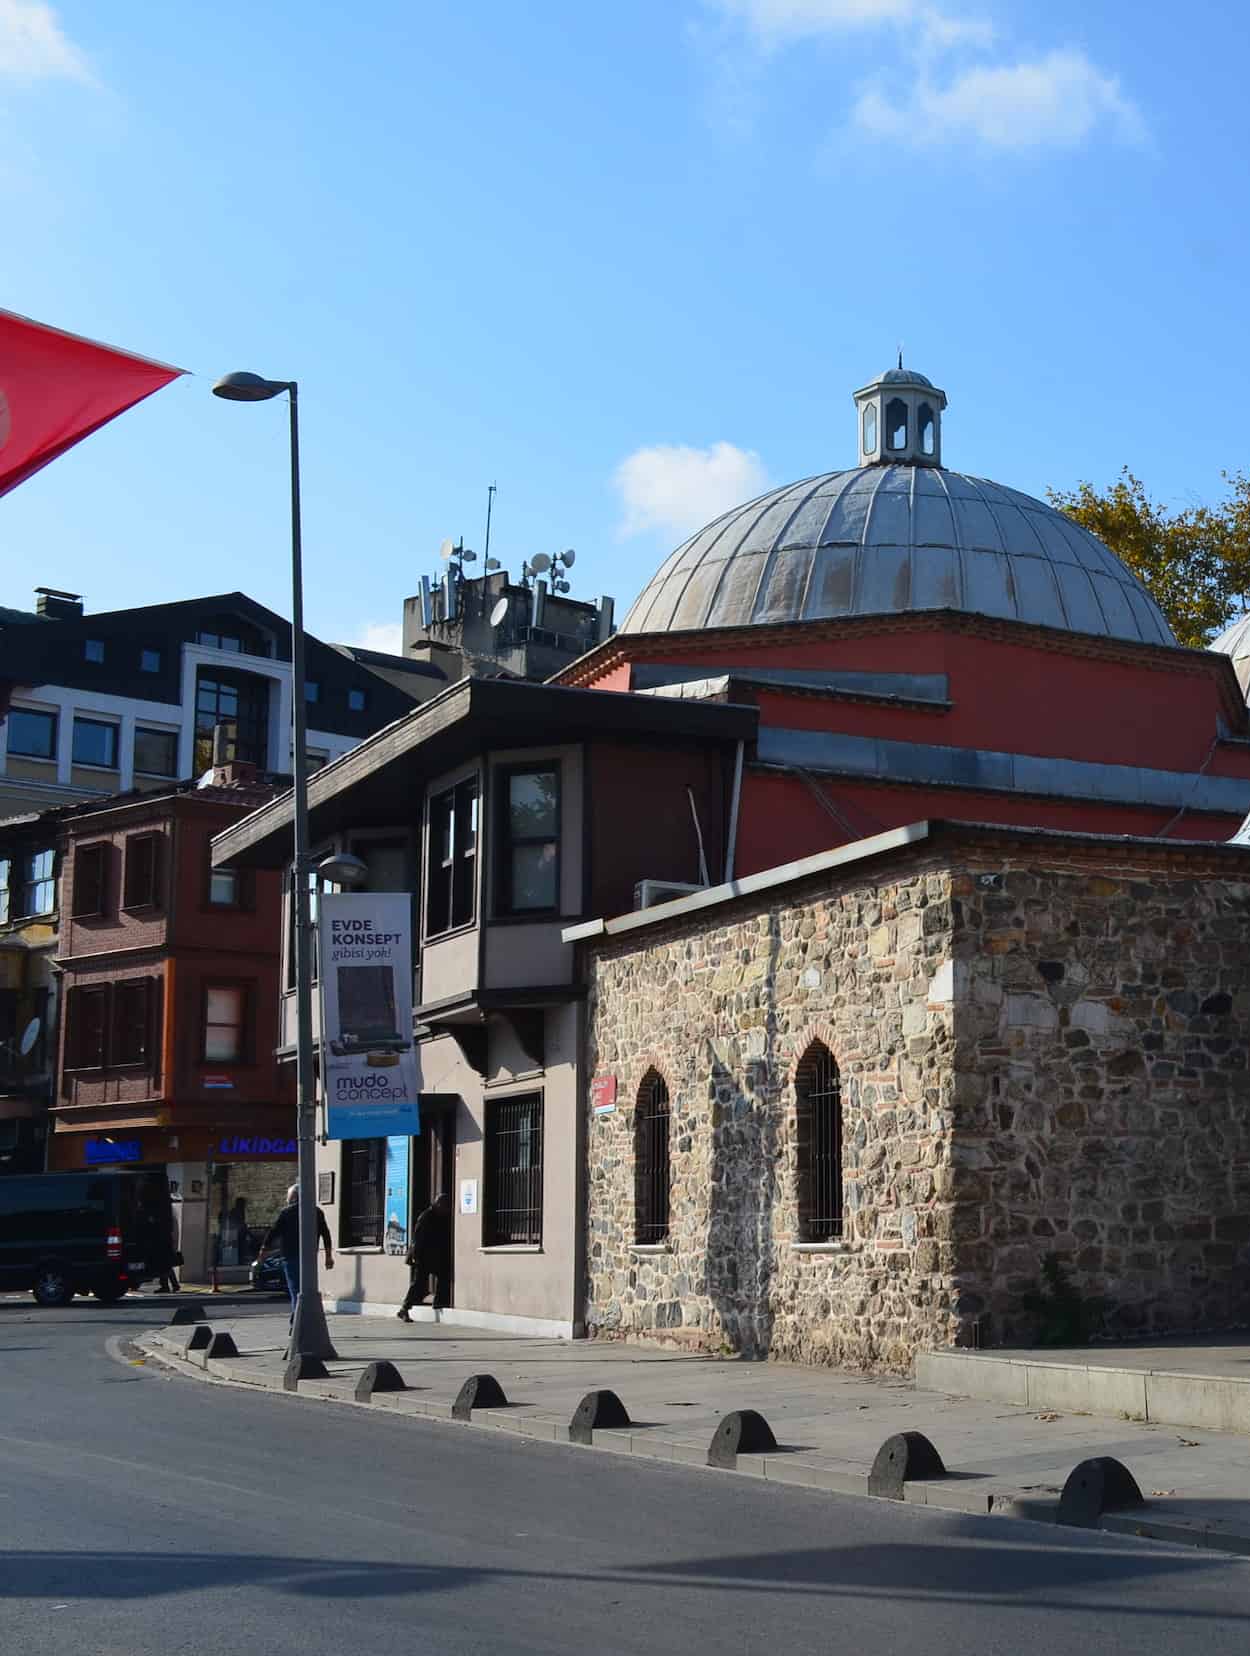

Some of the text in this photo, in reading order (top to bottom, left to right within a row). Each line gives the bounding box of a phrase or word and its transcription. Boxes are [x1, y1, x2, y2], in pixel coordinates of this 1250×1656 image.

[331, 919, 373, 931] EVDE
[331, 933, 402, 945] KONSEPT
[332, 946, 392, 961] gibisi yok!
[336, 1072, 389, 1089] mudo
[336, 1082, 409, 1104] concept
